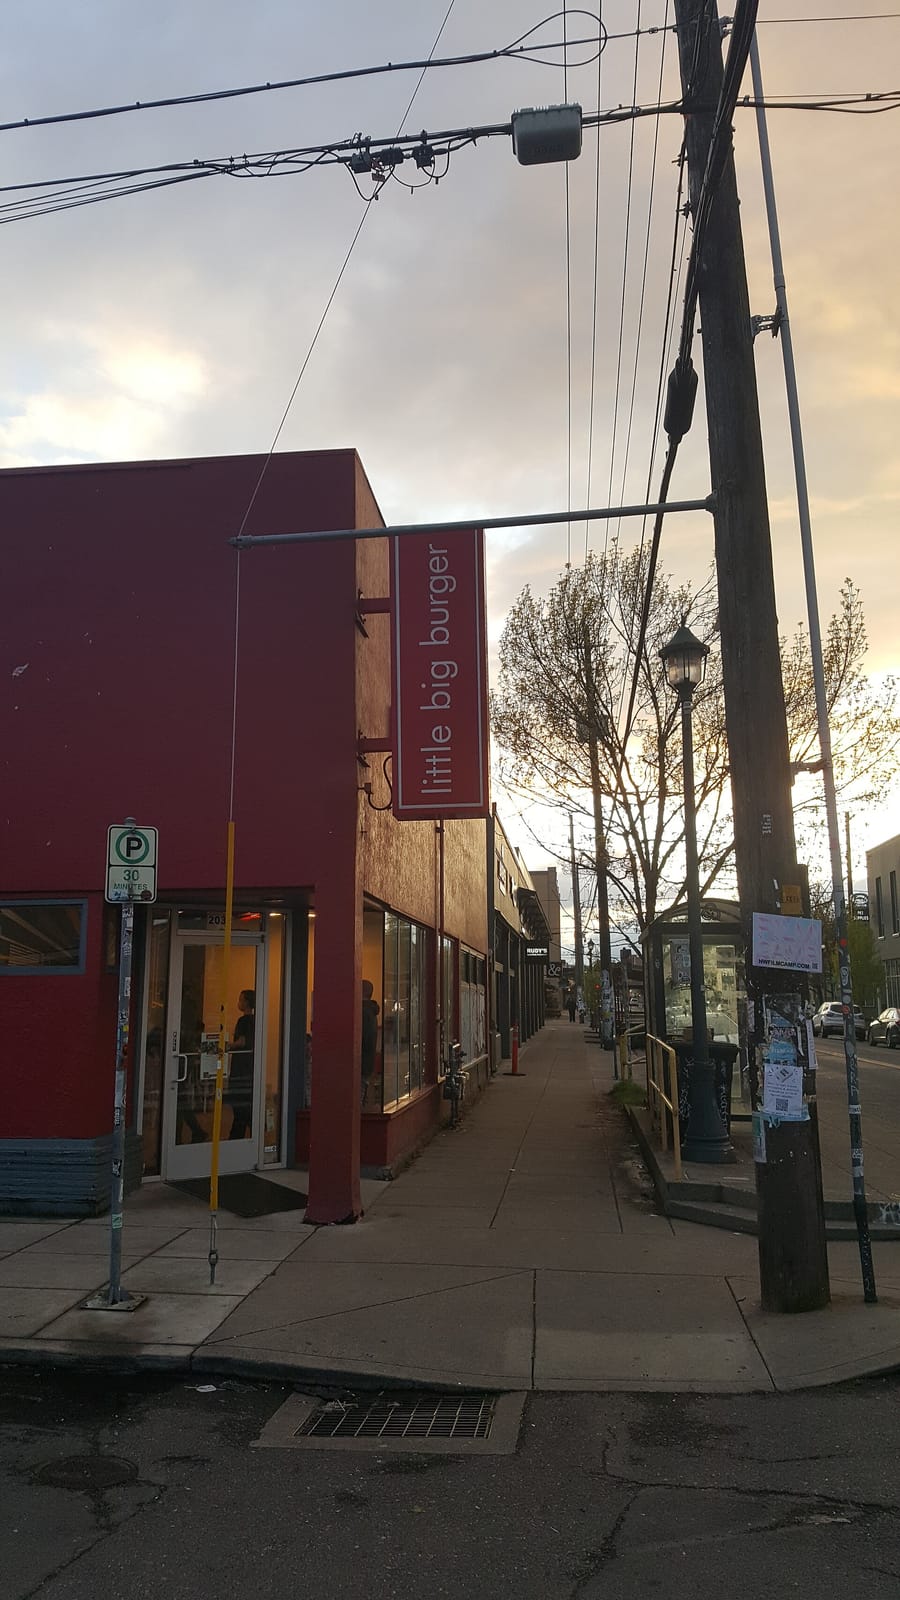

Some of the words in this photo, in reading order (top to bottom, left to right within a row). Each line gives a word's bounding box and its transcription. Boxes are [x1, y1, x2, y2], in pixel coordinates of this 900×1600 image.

[418, 543, 457, 646] burger
[419, 661, 459, 710] big
[420, 725, 453, 794] little
[125, 836, 143, 858] P
[113, 883, 148, 891] MINUTES
[123, 869, 140, 882] 30
